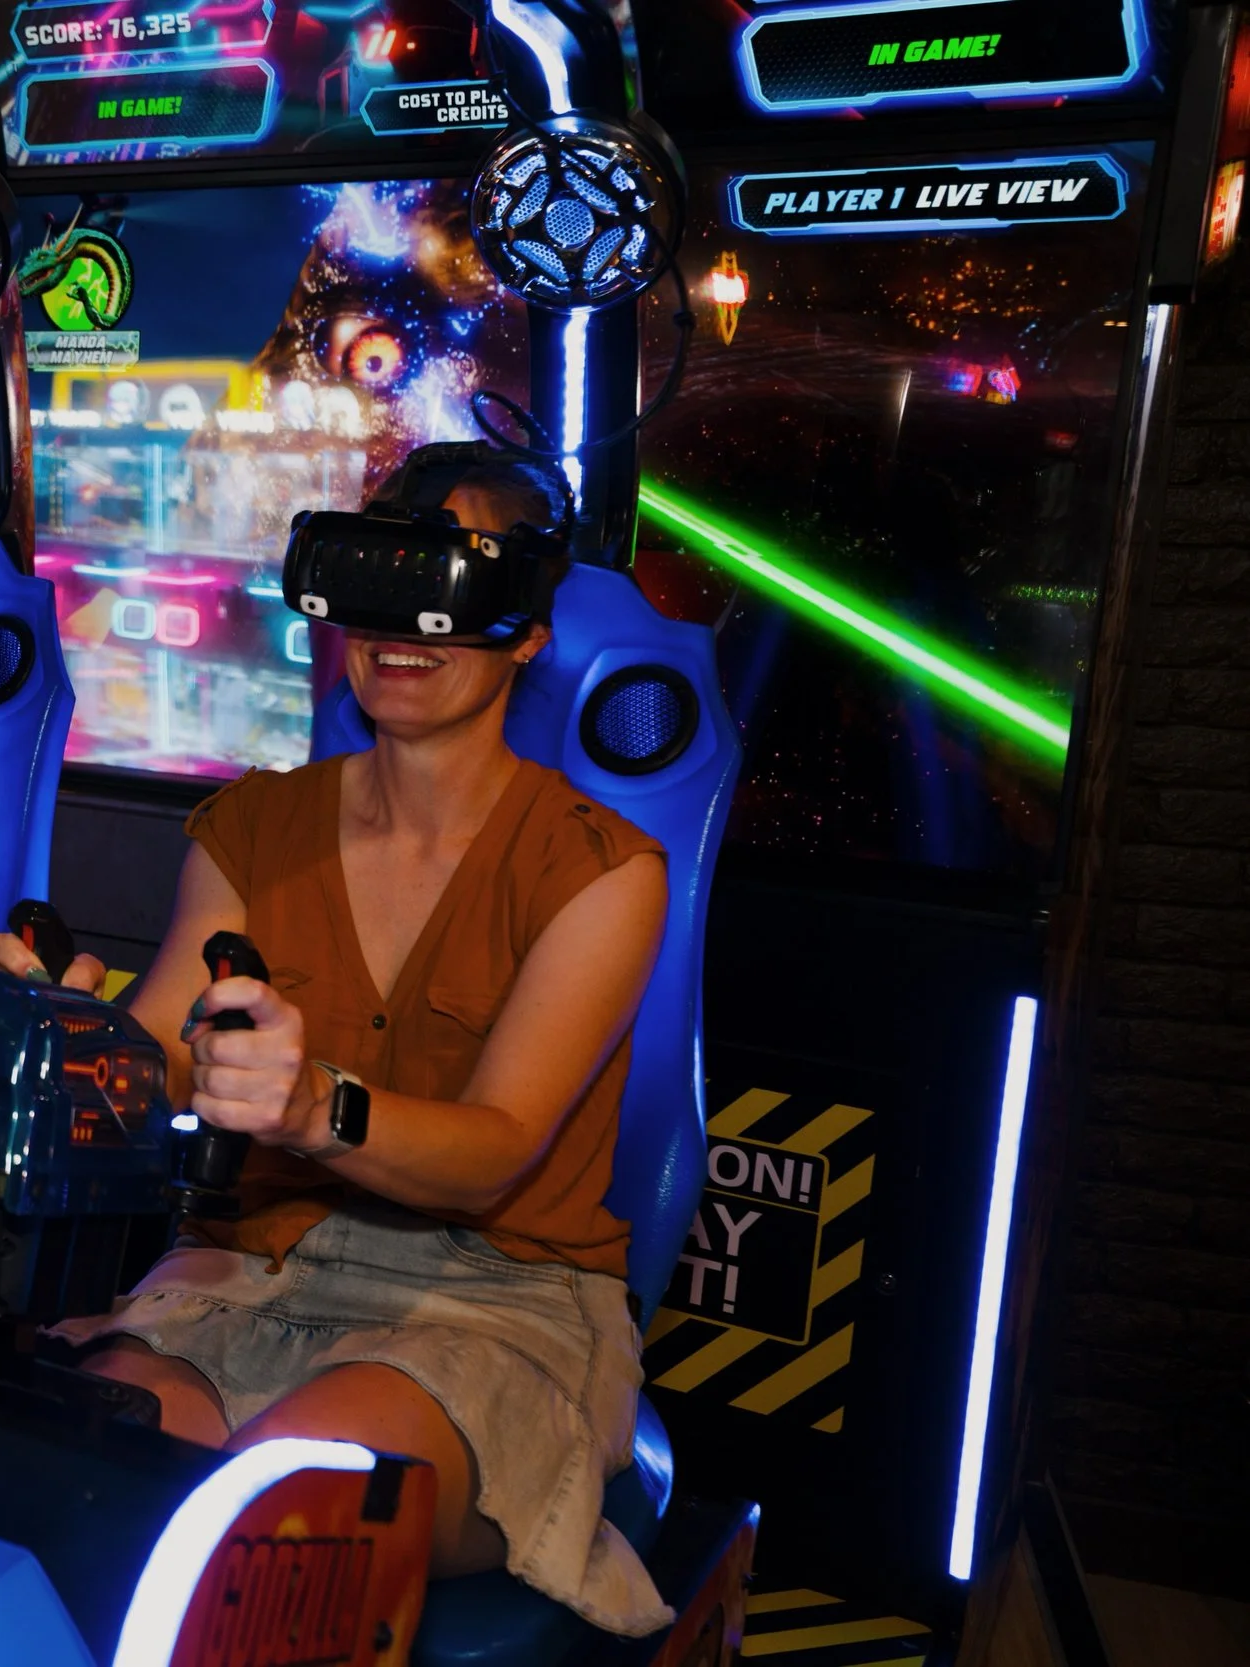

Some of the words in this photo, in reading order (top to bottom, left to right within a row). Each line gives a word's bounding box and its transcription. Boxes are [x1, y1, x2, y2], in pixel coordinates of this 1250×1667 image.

[24, 20, 103, 46] SCORE:
[108, 12, 192, 41] 76,325
[868, 43, 900, 65] IN
[903, 34, 1002, 62] GAME!
[98, 100, 117, 119] IN
[121, 95, 183, 117] GAME!
[399, 93, 440, 109] COST
[445, 91, 466, 106] TO
[437, 104, 509, 122] CREDITS
[764, 188, 883, 214] PLAYER
[890, 187, 905, 209] 1
[916, 183, 989, 208] LIVE
[998, 178, 1089, 204] VIEW
[55, 335, 106, 349] MANDA
[50, 350, 113, 364] MAYHEM
